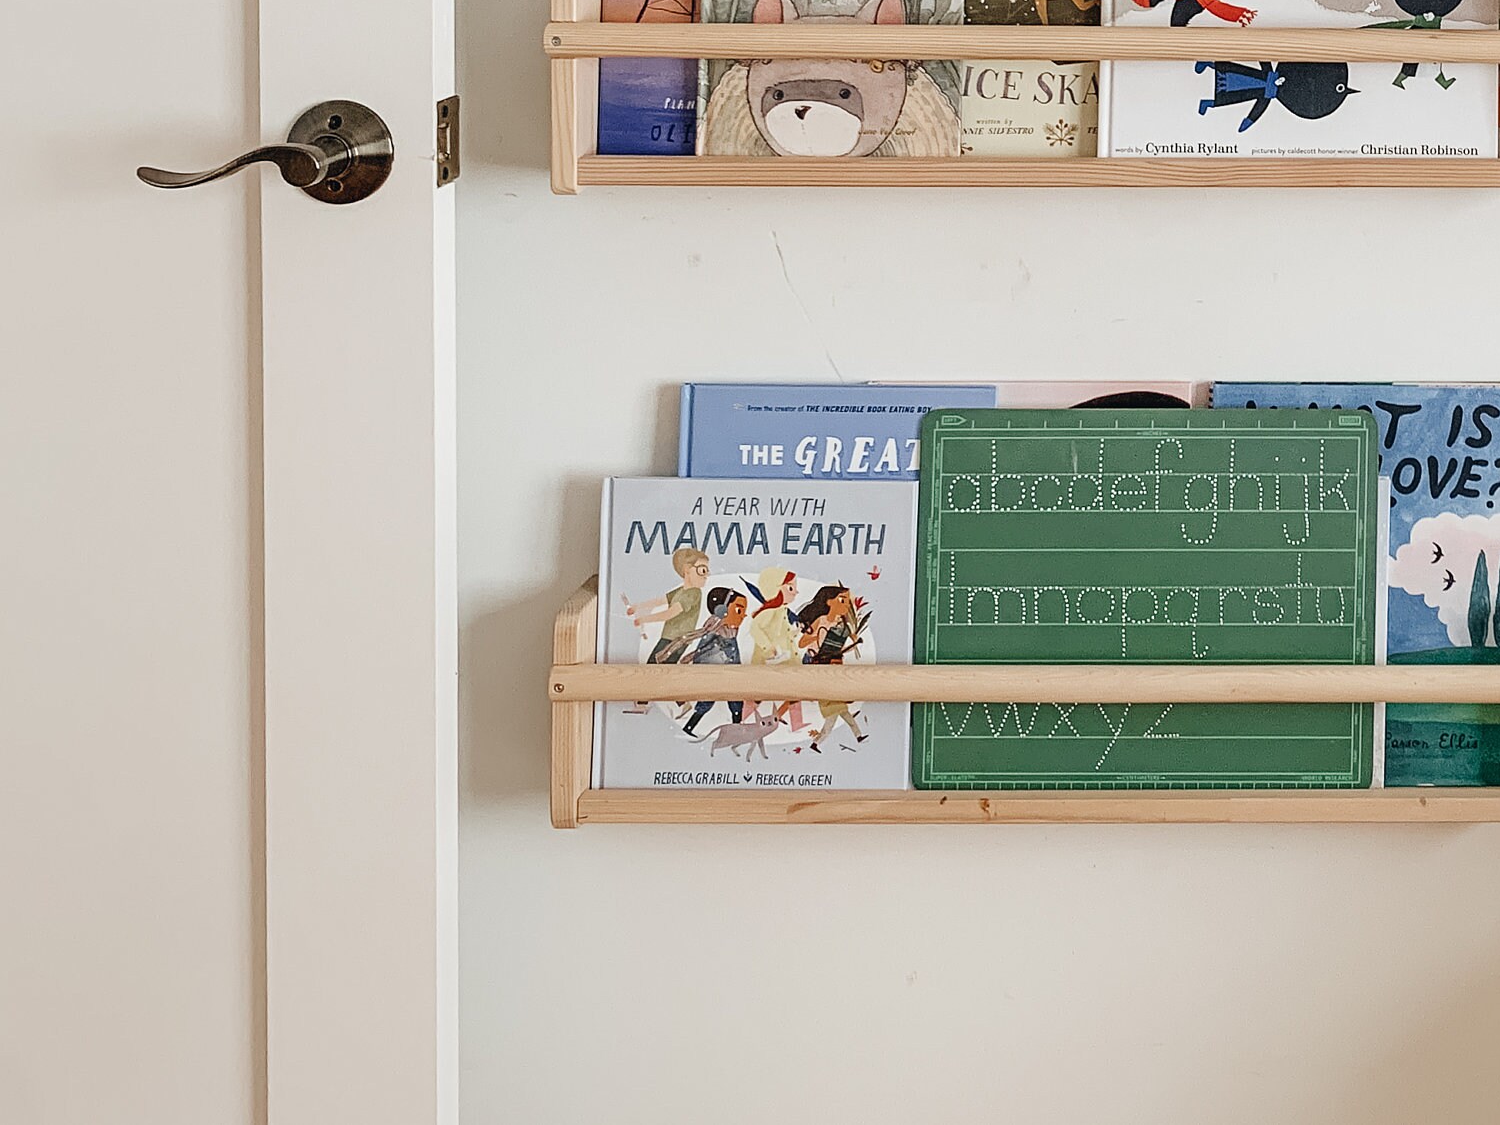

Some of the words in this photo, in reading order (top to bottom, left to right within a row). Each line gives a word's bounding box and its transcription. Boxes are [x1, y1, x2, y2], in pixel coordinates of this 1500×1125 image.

[960, 66, 1023, 100] ICE
[988, 127, 1034, 135] SILVESTRO
[1146, 142, 1195, 155] Cynthia
[1197, 143, 1238, 156] Rylant
[1251, 147, 1276, 155] pictures
[1277, 147, 1286, 155] by
[1287, 147, 1316, 155] caldecott
[1360, 144, 1418, 156] Christian
[1421, 145, 1479, 156] Robinson
[806, 405, 819, 413] THE
[822, 405, 865, 413] INCREDIBLE
[889, 406, 915, 414] EATING
[1447, 405, 1500, 448] IS
[739, 445, 784, 465] THE
[794, 436, 921, 475] GREAT
[691, 497, 703, 515] A
[714, 496, 760, 516] YEAR
[770, 497, 826, 516] WITH
[625, 521, 770, 555] MAMA
[781, 522, 886, 555] EARTH
[1439, 732, 1478, 750] Ellis
[654, 772, 694, 785] REBECCA
[695, 772, 740, 785] GRABILL
[755, 773, 795, 786] REBECCA
[798, 774, 832, 786] GREEN
